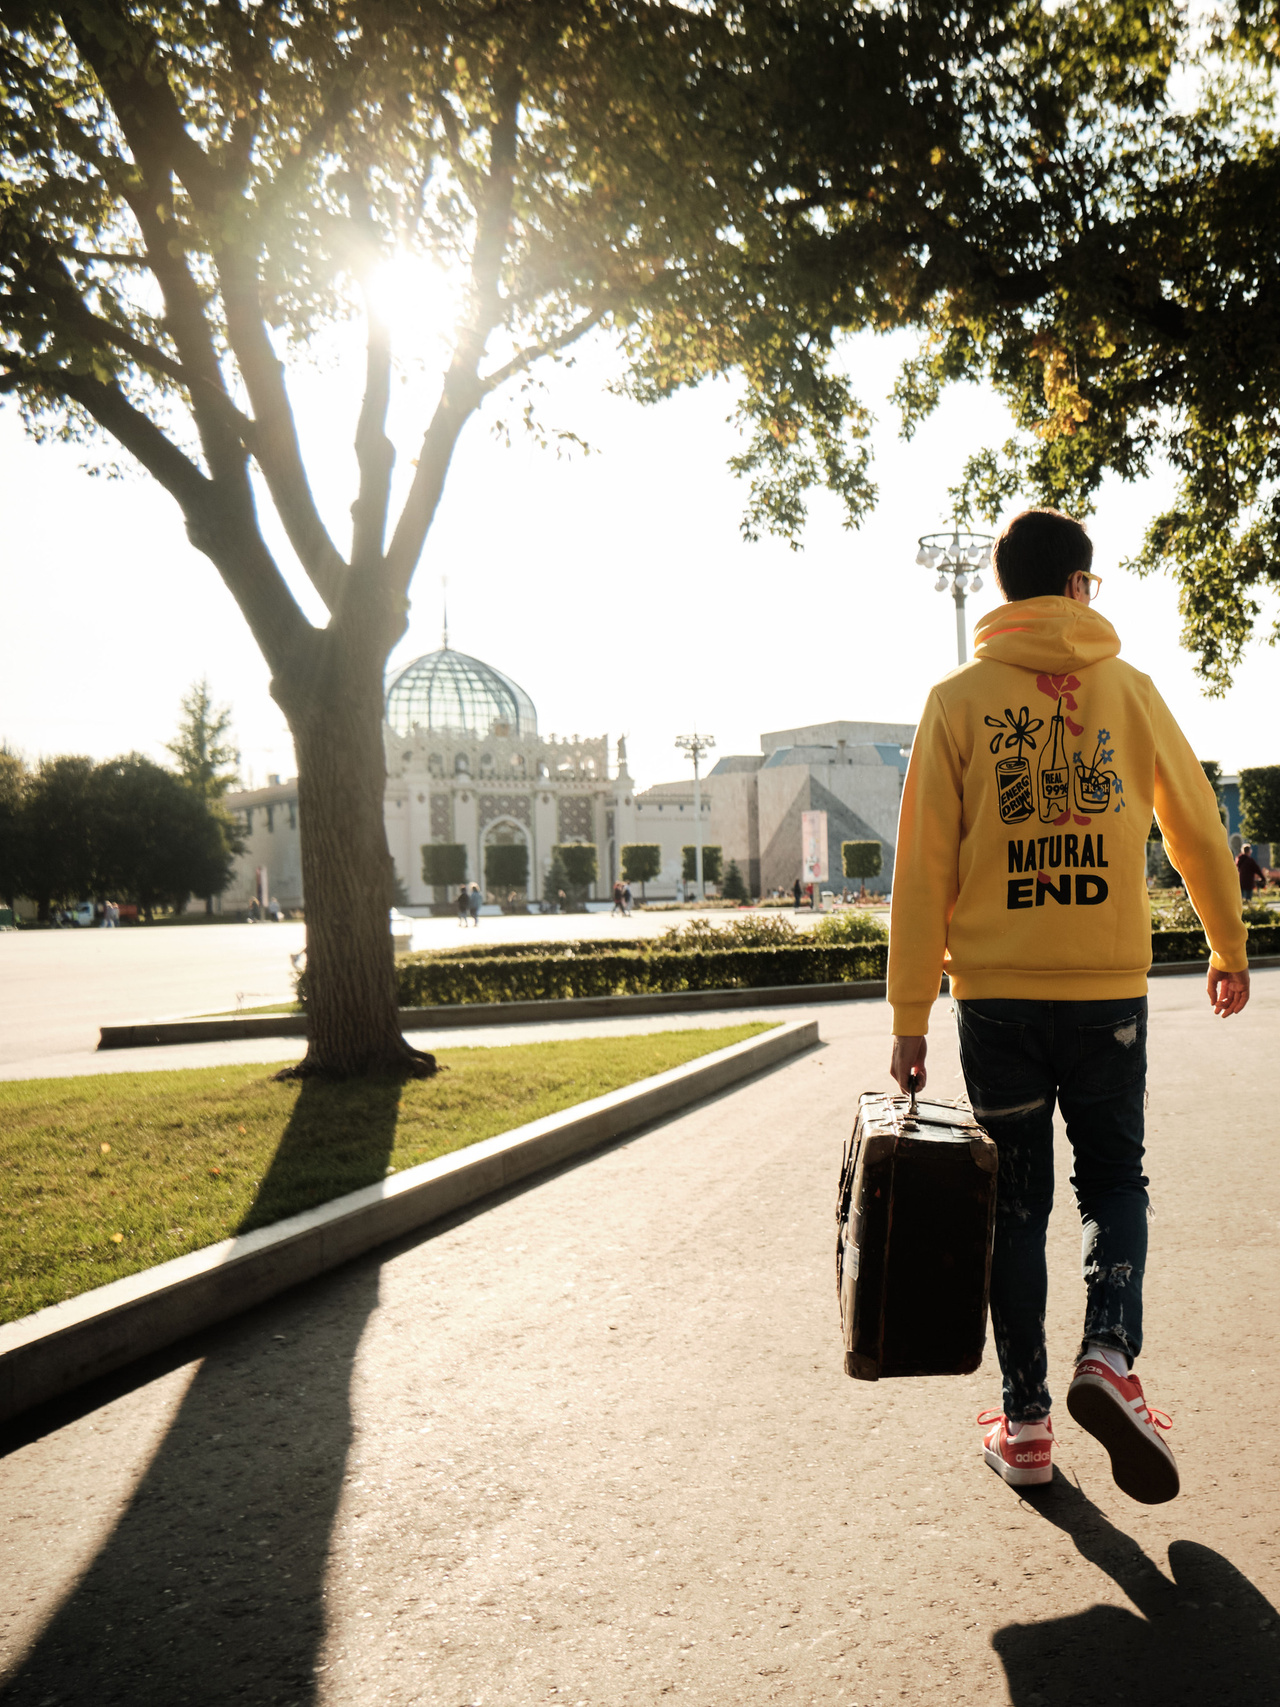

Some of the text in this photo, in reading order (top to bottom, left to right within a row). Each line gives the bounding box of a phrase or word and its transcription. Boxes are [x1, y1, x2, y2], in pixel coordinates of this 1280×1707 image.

[1045, 772, 1063, 785] REAL
[1045, 783, 1068, 796] 99%
[1082, 782, 1110, 794] FRSH
[1008, 833, 1109, 874] NATURAL
[1007, 874, 1109, 910] END
